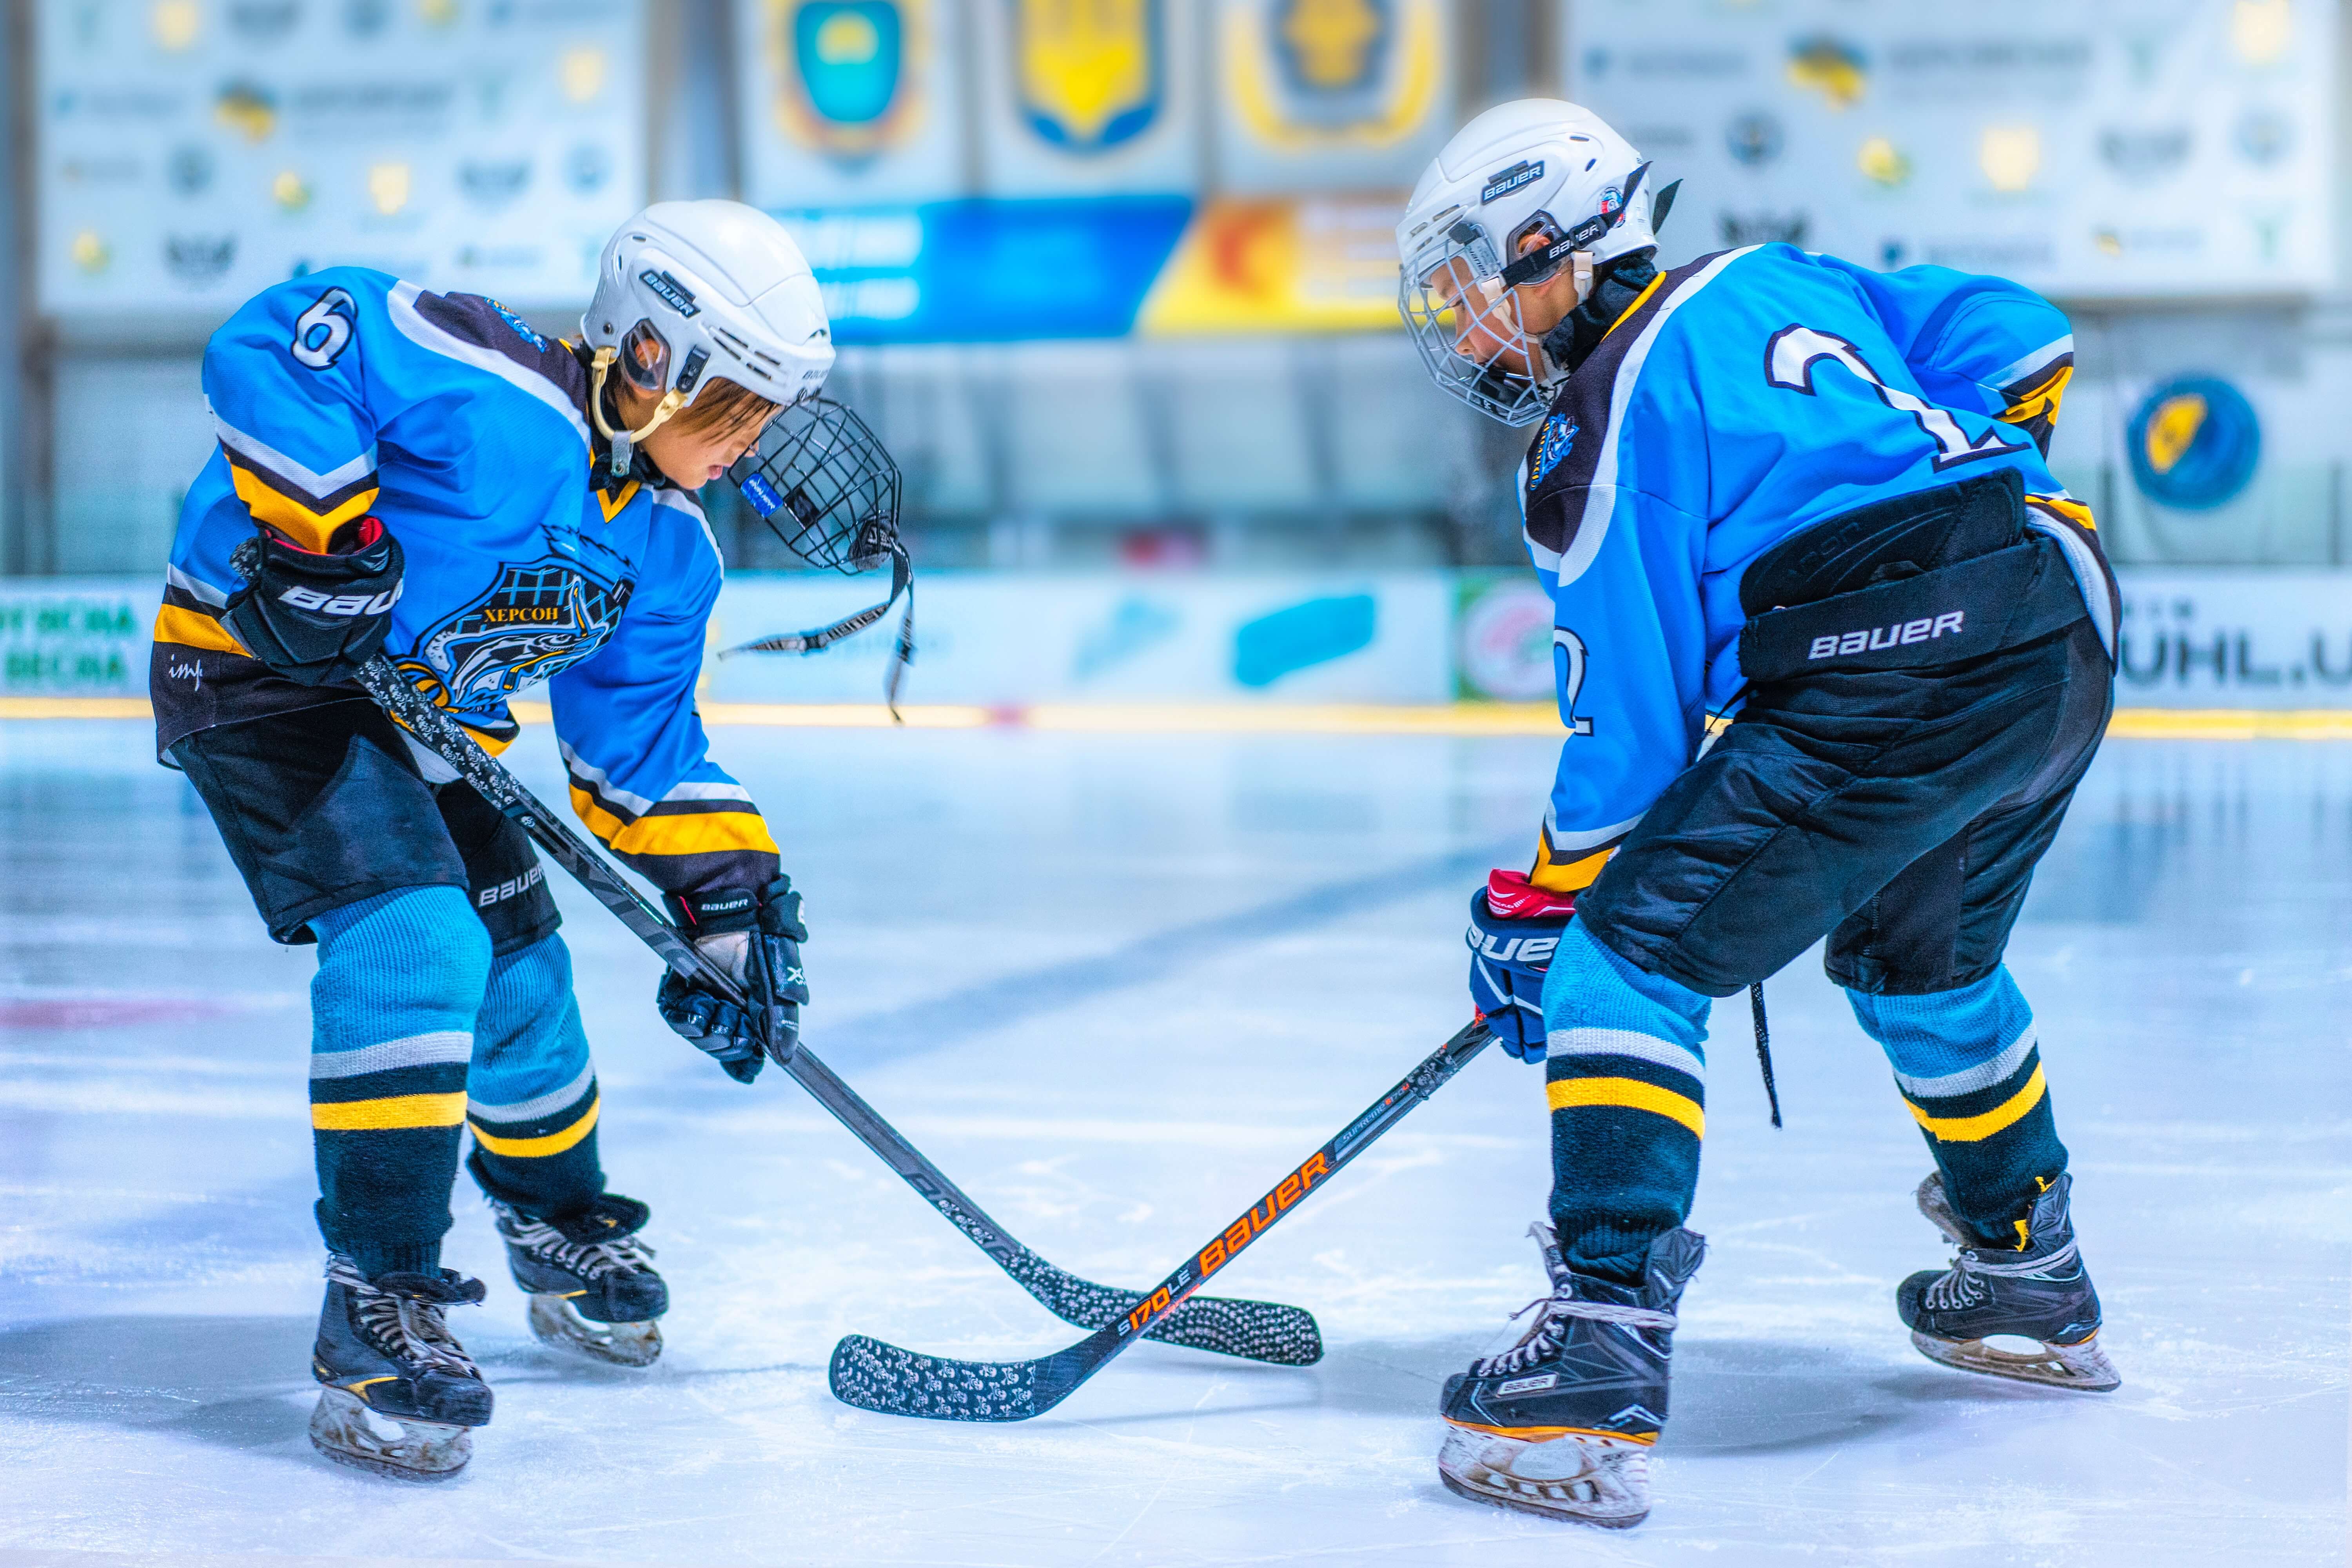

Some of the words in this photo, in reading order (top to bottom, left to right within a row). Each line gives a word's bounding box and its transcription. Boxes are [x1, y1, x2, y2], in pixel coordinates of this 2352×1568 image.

[1484, 166, 1541, 202] BAUER
[642, 270, 695, 318] BAUER
[291, 286, 359, 371] 6
[1764, 323, 2032, 474] 2
[484, 607, 558, 622] ХЕРСОН
[1808, 610, 1965, 660] BAUER
[701, 899, 748, 911] BAUER
[1200, 1151, 1329, 1277] BAUER
[1502, 1377, 1550, 1392] BAUER
